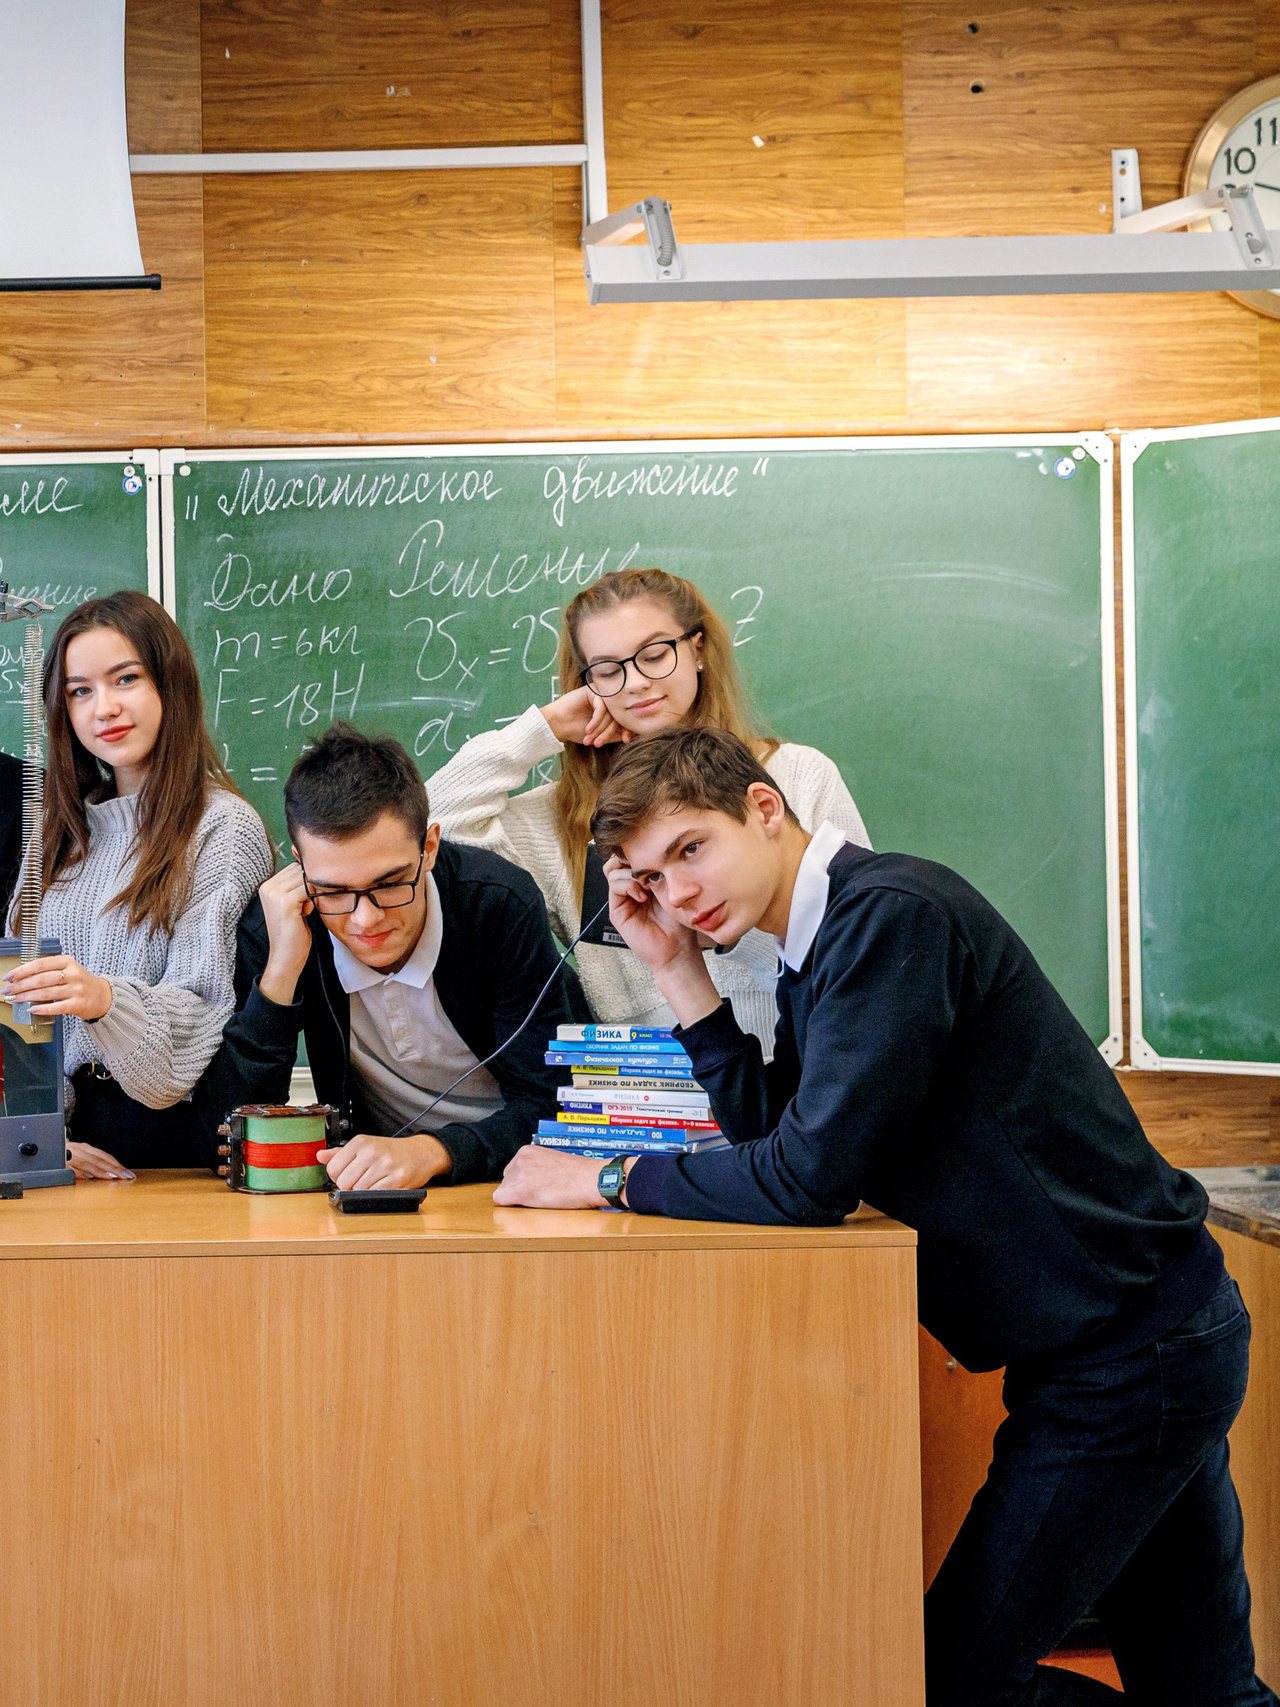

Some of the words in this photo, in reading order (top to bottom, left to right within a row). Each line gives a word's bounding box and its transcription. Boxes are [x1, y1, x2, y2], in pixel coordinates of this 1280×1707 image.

[1255, 117, 1278, 146] 11
[1224, 147, 1256, 175] 10
[203, 534, 353, 612] Дано
[388, 518, 641, 599] Решени
[581, 1030, 623, 1039] ФИЗИКА
[630, 1032, 638, 1040] 9
[584, 1055, 624, 1063] Физическая
[627, 1057, 658, 1065] культура
[588, 1079, 618, 1087] ФИЗИКЕ
[632, 1080, 658, 1088] ЗАДАЧ
[659, 1081, 694, 1089] СБОРНИК
[613, 1093, 640, 1101] ФИЗИКА
[569, 1102, 593, 1110] ФИЗИКА
[610, 1116, 633, 1124] Сборник
[567, 1125, 596, 1134] ФИЗИКЕ
[610, 1128, 646, 1136] ЗАДАЧА
[538, 1136, 571, 1147] ФИЗИКА
